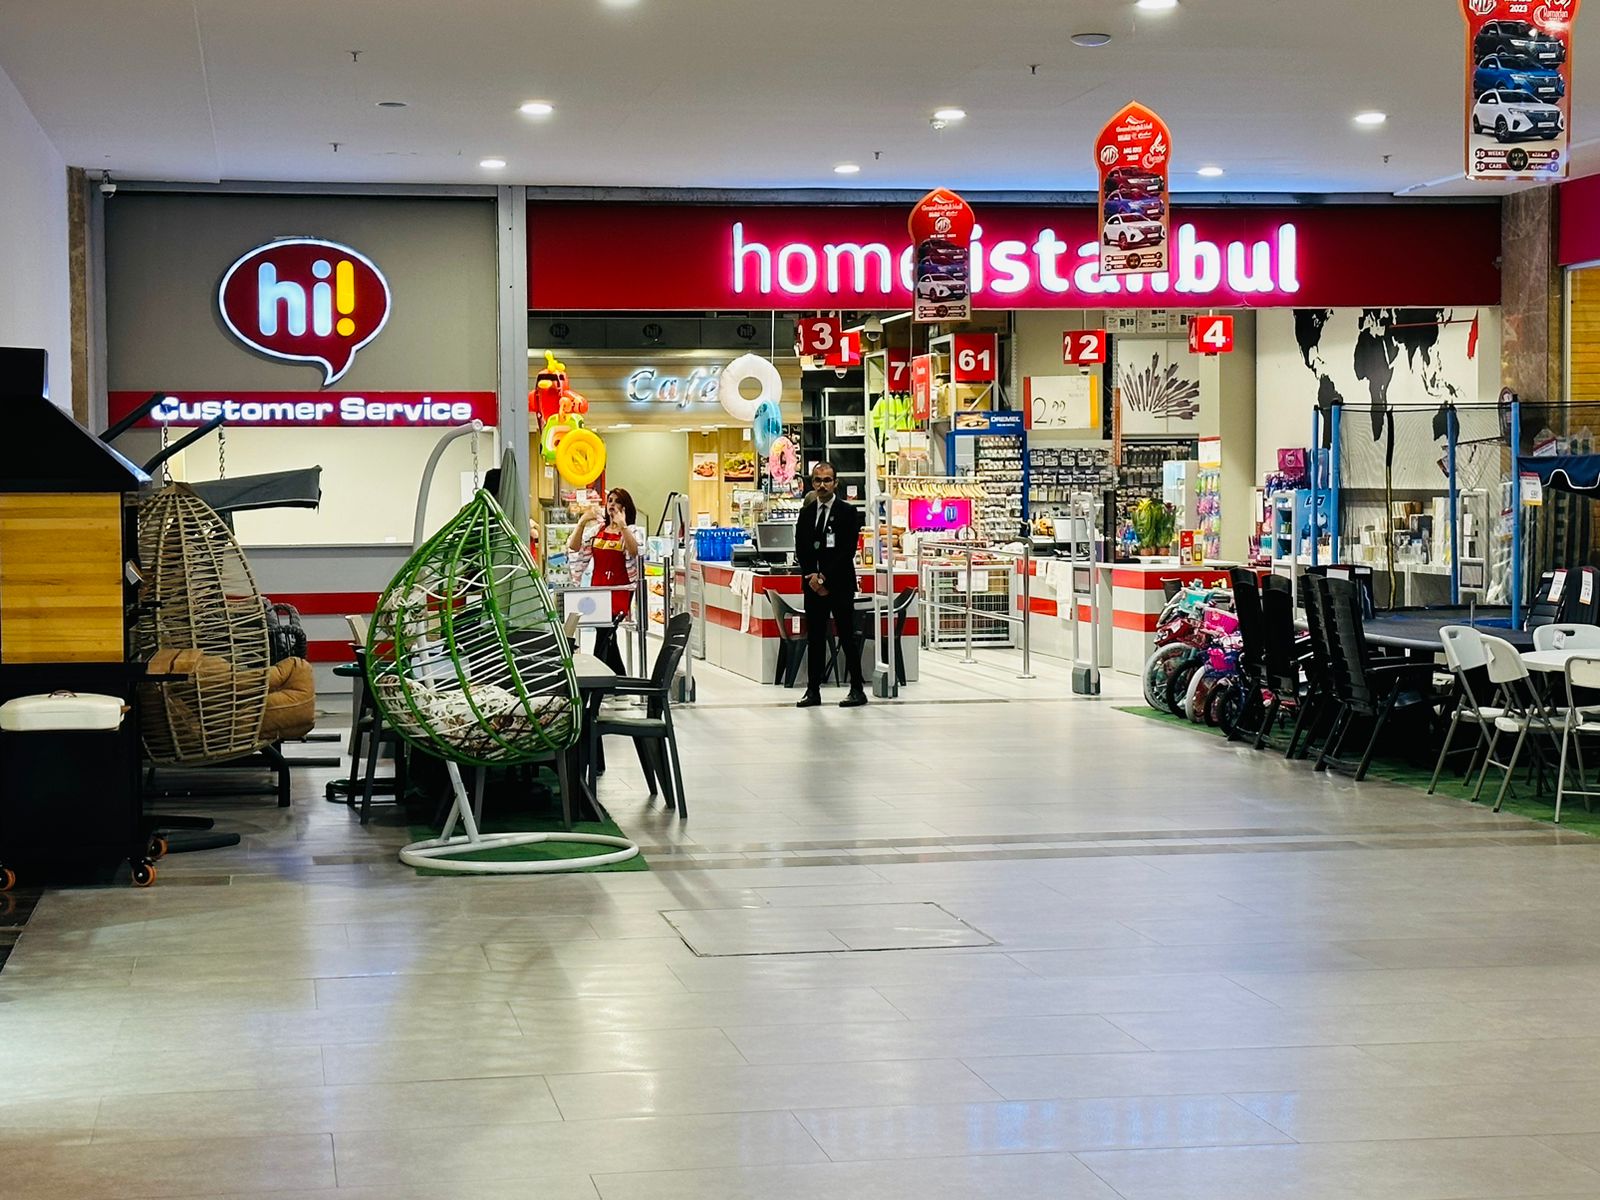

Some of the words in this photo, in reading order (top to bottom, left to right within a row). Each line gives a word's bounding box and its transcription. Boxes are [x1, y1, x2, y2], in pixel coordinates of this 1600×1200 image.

[257, 259, 356, 337] hi!
[811, 323, 833, 350] 3
[1079, 334, 1099, 360] 2
[1203, 320, 1226, 348] 4
[959, 349, 990, 371] 61
[627, 366, 721, 410] Café
[151, 396, 334, 421] Customer
[340, 396, 472, 421] Service
